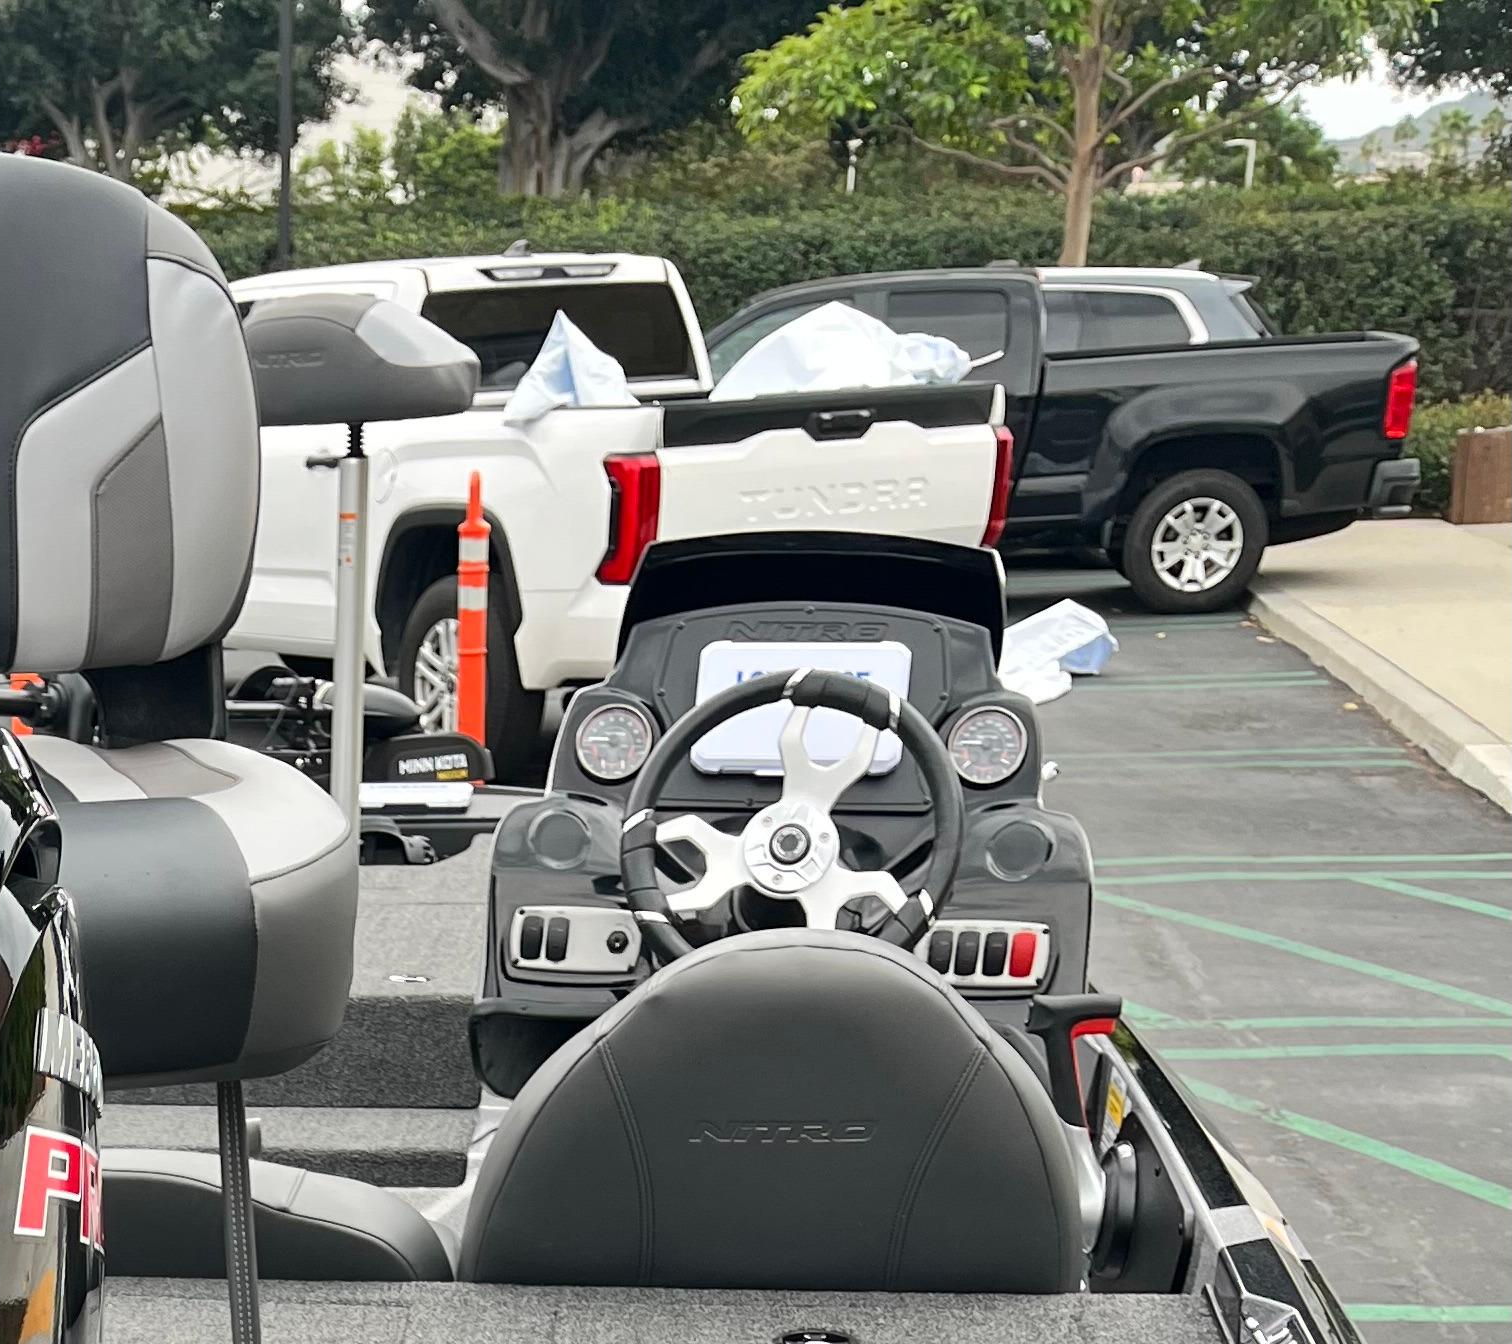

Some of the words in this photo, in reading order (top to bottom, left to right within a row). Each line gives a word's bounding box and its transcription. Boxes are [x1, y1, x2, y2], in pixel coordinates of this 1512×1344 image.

[739, 477, 928, 522] TUNDRA
[726, 620, 889, 642] NITRO
[688, 1119, 878, 1143] NITRO
